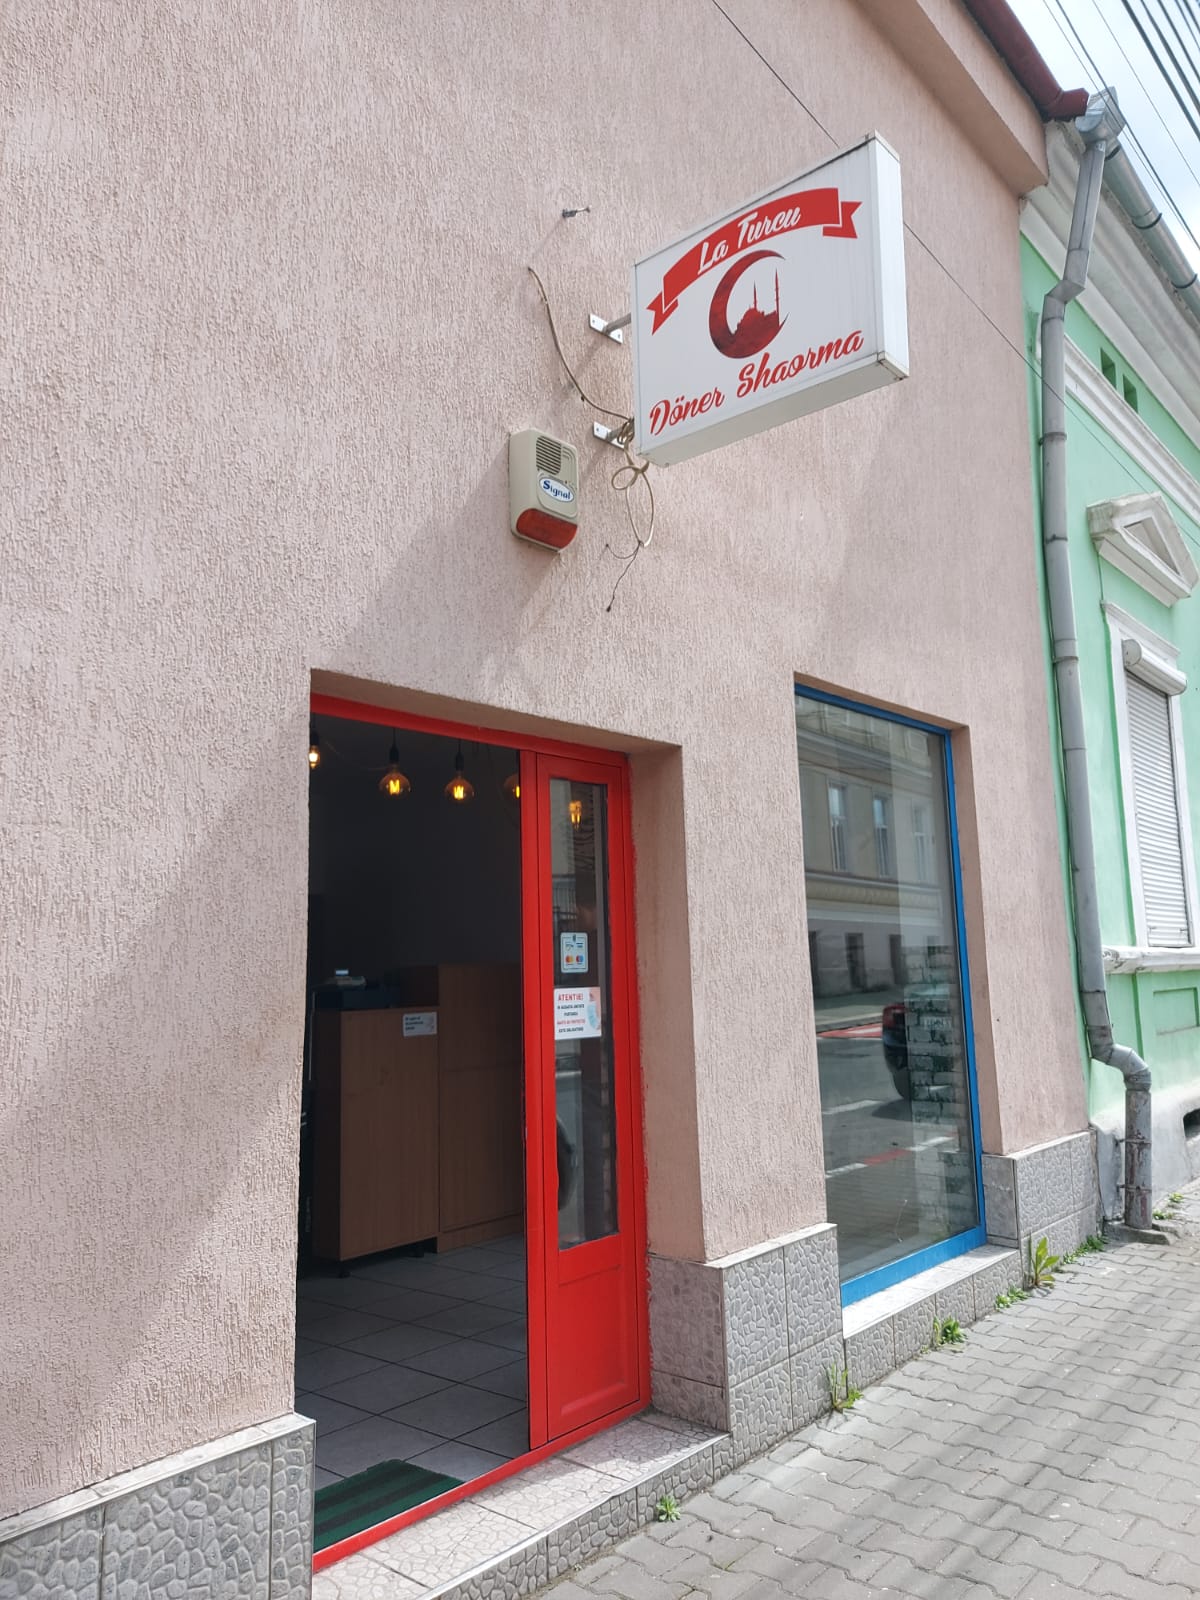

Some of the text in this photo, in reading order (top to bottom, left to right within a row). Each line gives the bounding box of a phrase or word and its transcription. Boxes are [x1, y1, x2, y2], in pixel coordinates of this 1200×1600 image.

[698, 206, 801, 275] La Turcu
[649, 330, 864, 436] Döner Shaorma
[543, 480, 571, 500] Signal
